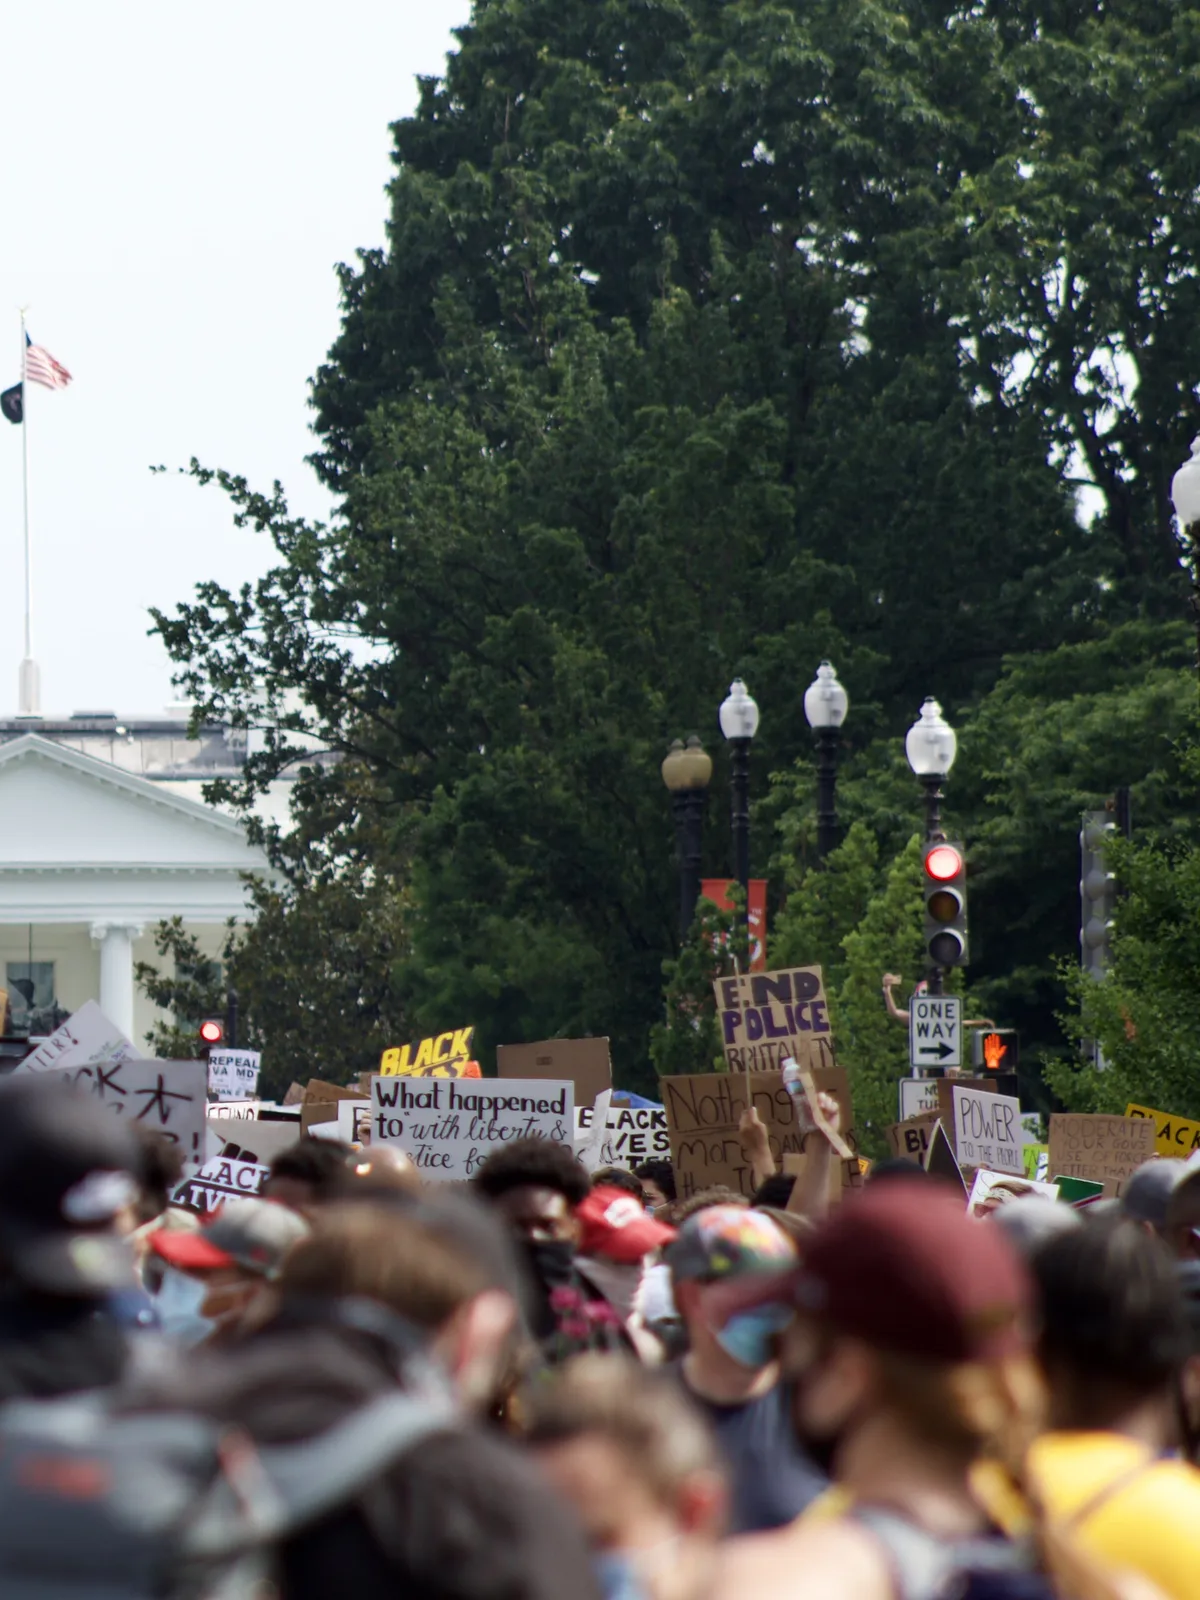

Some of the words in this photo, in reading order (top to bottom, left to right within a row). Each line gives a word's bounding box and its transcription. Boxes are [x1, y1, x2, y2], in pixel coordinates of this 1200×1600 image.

[722, 1000, 830, 1045] POLICE
[917, 1003, 955, 1019] ONE
[917, 1023, 955, 1038] WAY
[210, 1055, 260, 1069] REPEAL
[380, 1026, 473, 1077] BLACK
[375, 1081, 443, 1109] What
[449, 1082, 566, 1120] happened
[666, 1078, 794, 1131] Nothng
[375, 1112, 402, 1139] to
[551, 1120, 568, 1141] &
[960, 1097, 1015, 1143] POWER
[961, 1141, 975, 1158] TO
[977, 1145, 994, 1163] THE
